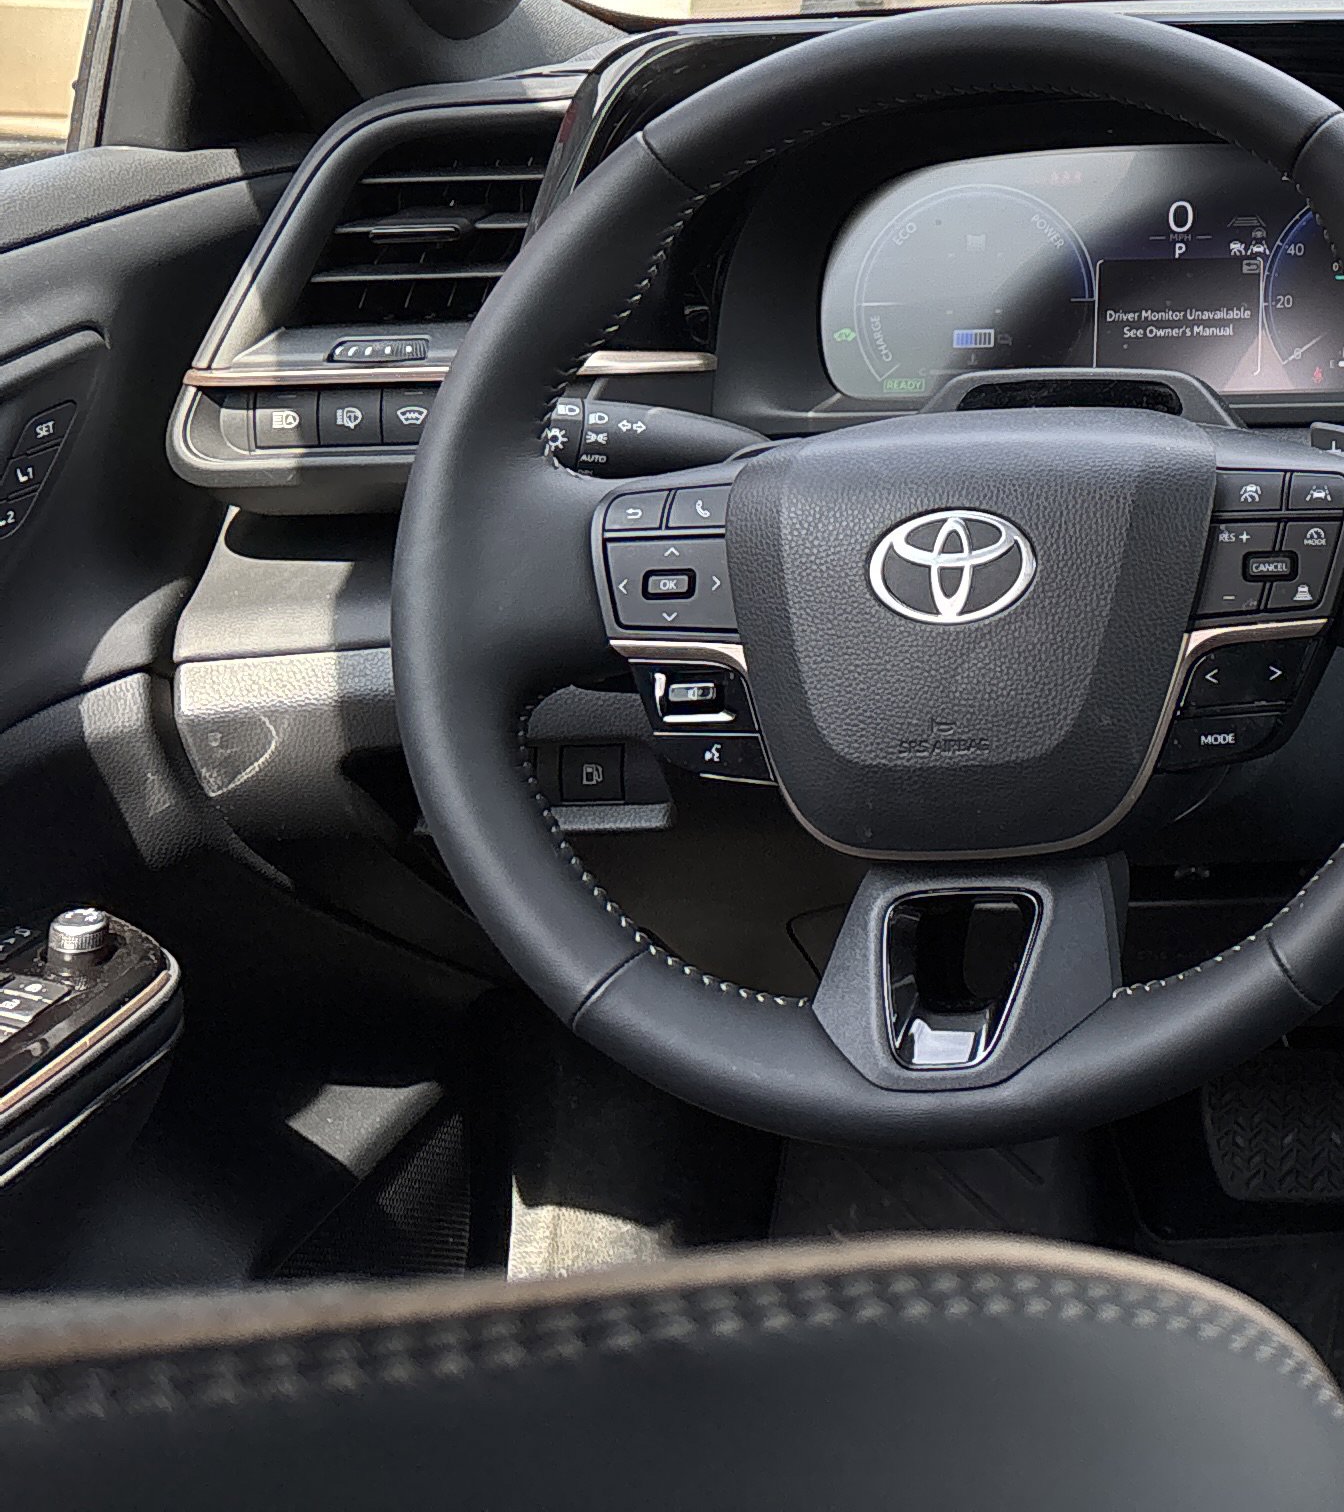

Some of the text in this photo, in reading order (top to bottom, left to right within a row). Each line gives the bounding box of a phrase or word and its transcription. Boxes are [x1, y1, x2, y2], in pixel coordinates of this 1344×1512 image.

[892, 222, 917, 246] ECO
[1030, 213, 1065, 250] POWER
[1174, 243, 1186, 259] P
[1287, 243, 1305, 256] 40
[1276, 295, 1293, 308] 20
[1106, 308, 1251, 322] Driver Monitor Unavailable
[1123, 324, 1233, 338] See Owner's Manual
[870, 315, 892, 362] CHARGE
[886, 381, 922, 391] READY
[35, 420, 55, 438] SET
[579, 454, 607, 463] AUTO
[1303, 538, 1327, 546] MODE
[1252, 562, 1288, 573] CANCEL
[659, 579, 677, 590] OK
[1200, 733, 1236, 746] MODE
